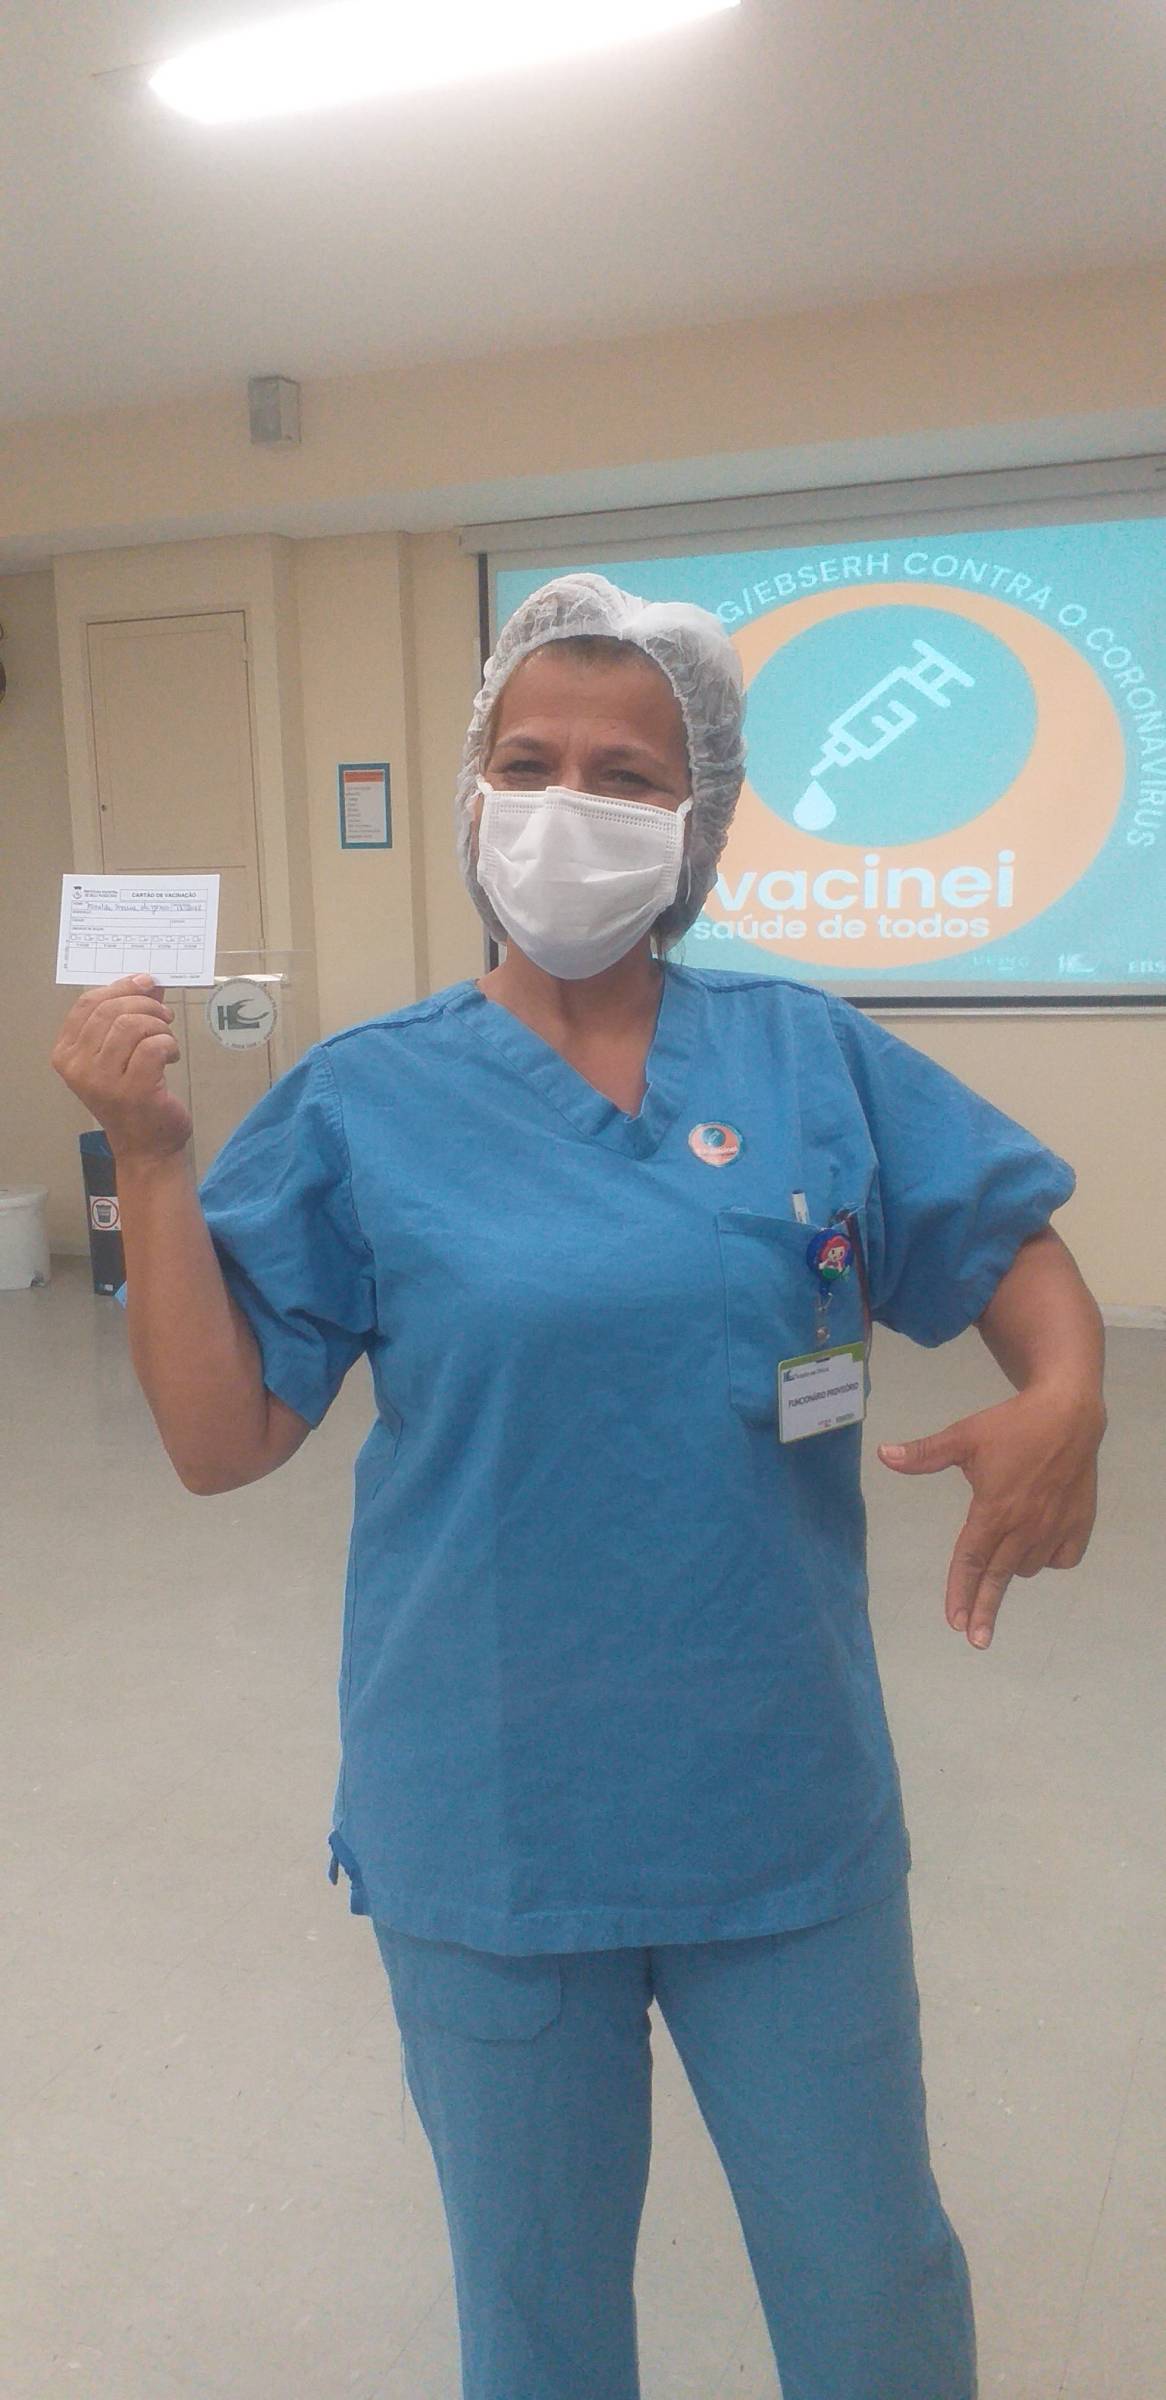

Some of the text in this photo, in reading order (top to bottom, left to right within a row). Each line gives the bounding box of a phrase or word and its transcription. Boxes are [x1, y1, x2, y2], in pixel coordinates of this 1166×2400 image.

[903, 551, 1050, 611] CONTRA
[1058, 603, 1089, 628] O
[716, 849, 1016, 912] vacinei
[693, 913, 990, 941] saúde de todos
